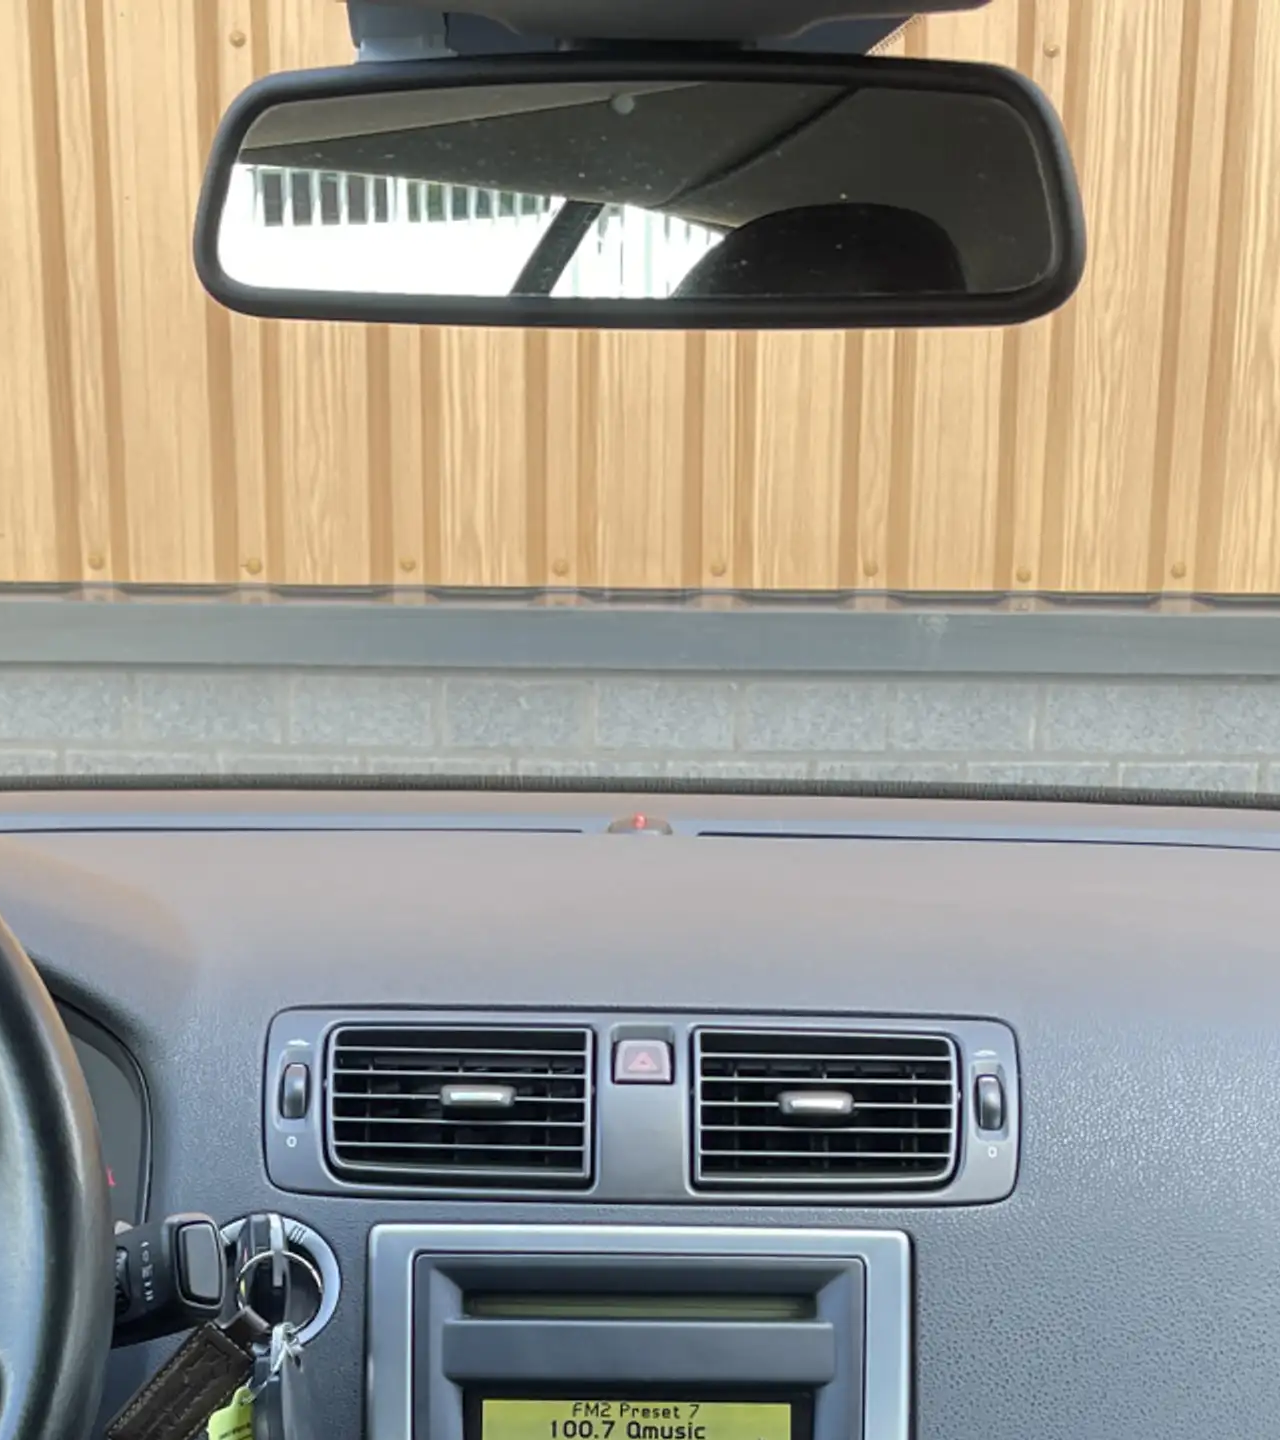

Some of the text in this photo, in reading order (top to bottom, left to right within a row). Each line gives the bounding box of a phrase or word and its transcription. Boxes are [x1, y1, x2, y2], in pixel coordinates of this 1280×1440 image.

[572, 1401, 700, 1419] FM2 Preset 7
[550, 1420, 706, 1440] 100.7 Qmusic
